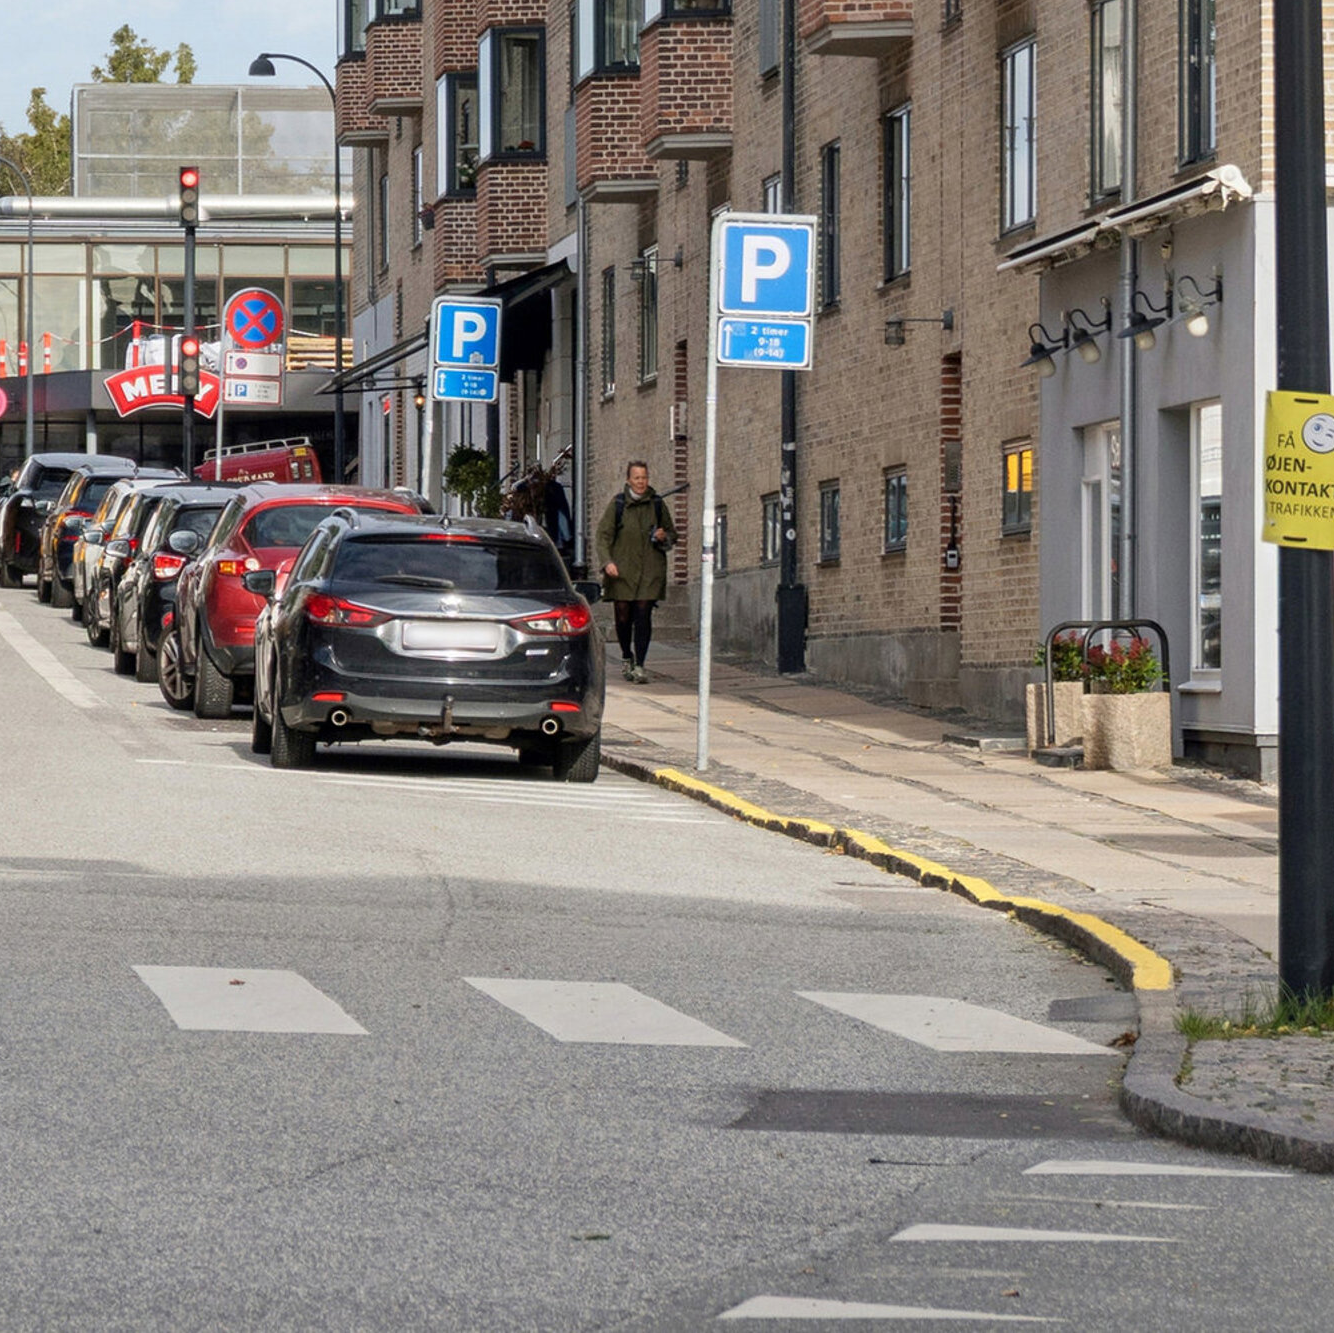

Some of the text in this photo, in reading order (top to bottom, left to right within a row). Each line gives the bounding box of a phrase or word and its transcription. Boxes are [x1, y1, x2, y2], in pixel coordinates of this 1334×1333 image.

[741, 234, 791, 304] P
[452, 310, 487, 358] P
[750, 325, 788, 336] 2 timer
[1277, 431, 1295, 449] FÅ
[1266, 454, 1312, 473] ØJEN-
